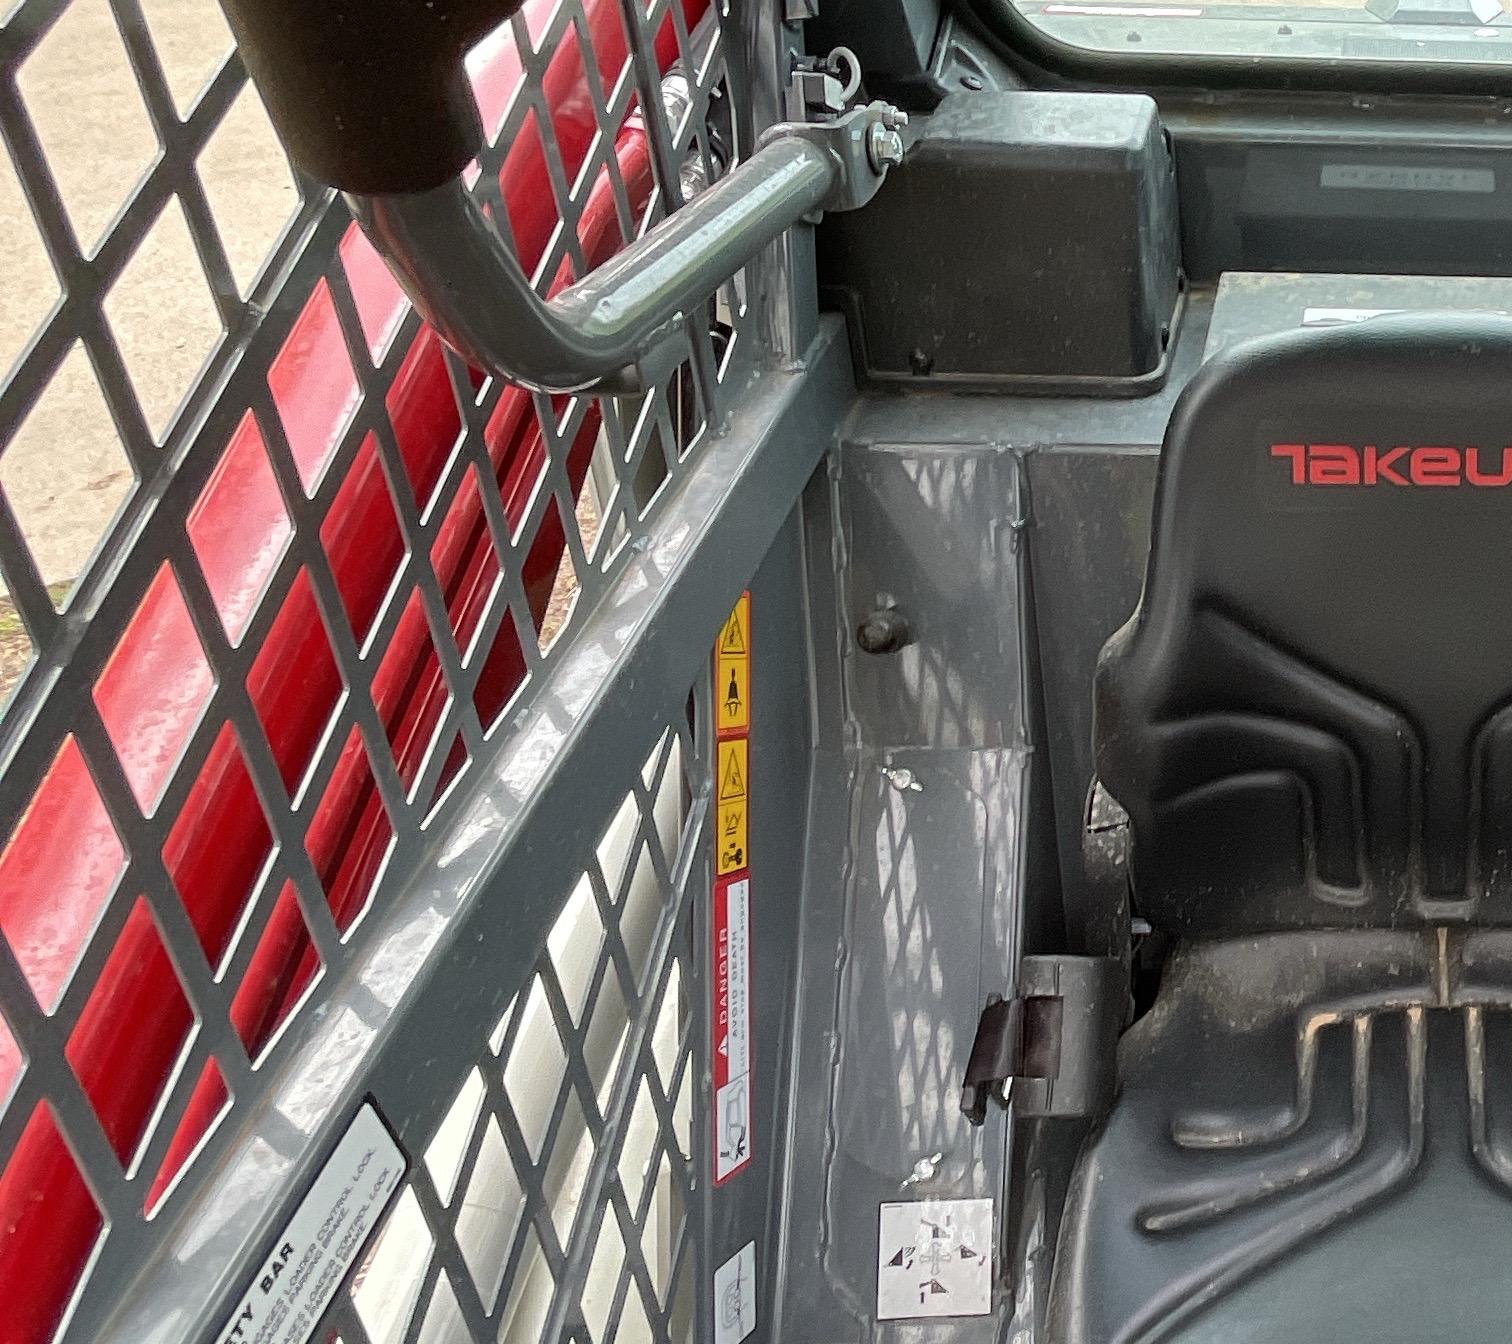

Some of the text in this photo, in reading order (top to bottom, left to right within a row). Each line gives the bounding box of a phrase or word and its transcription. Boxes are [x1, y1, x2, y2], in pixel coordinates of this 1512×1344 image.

[719, 928, 727, 1025] DANGER
[315, 1181, 353, 1243] CONTROL
[259, 1239, 294, 1296] BAR
